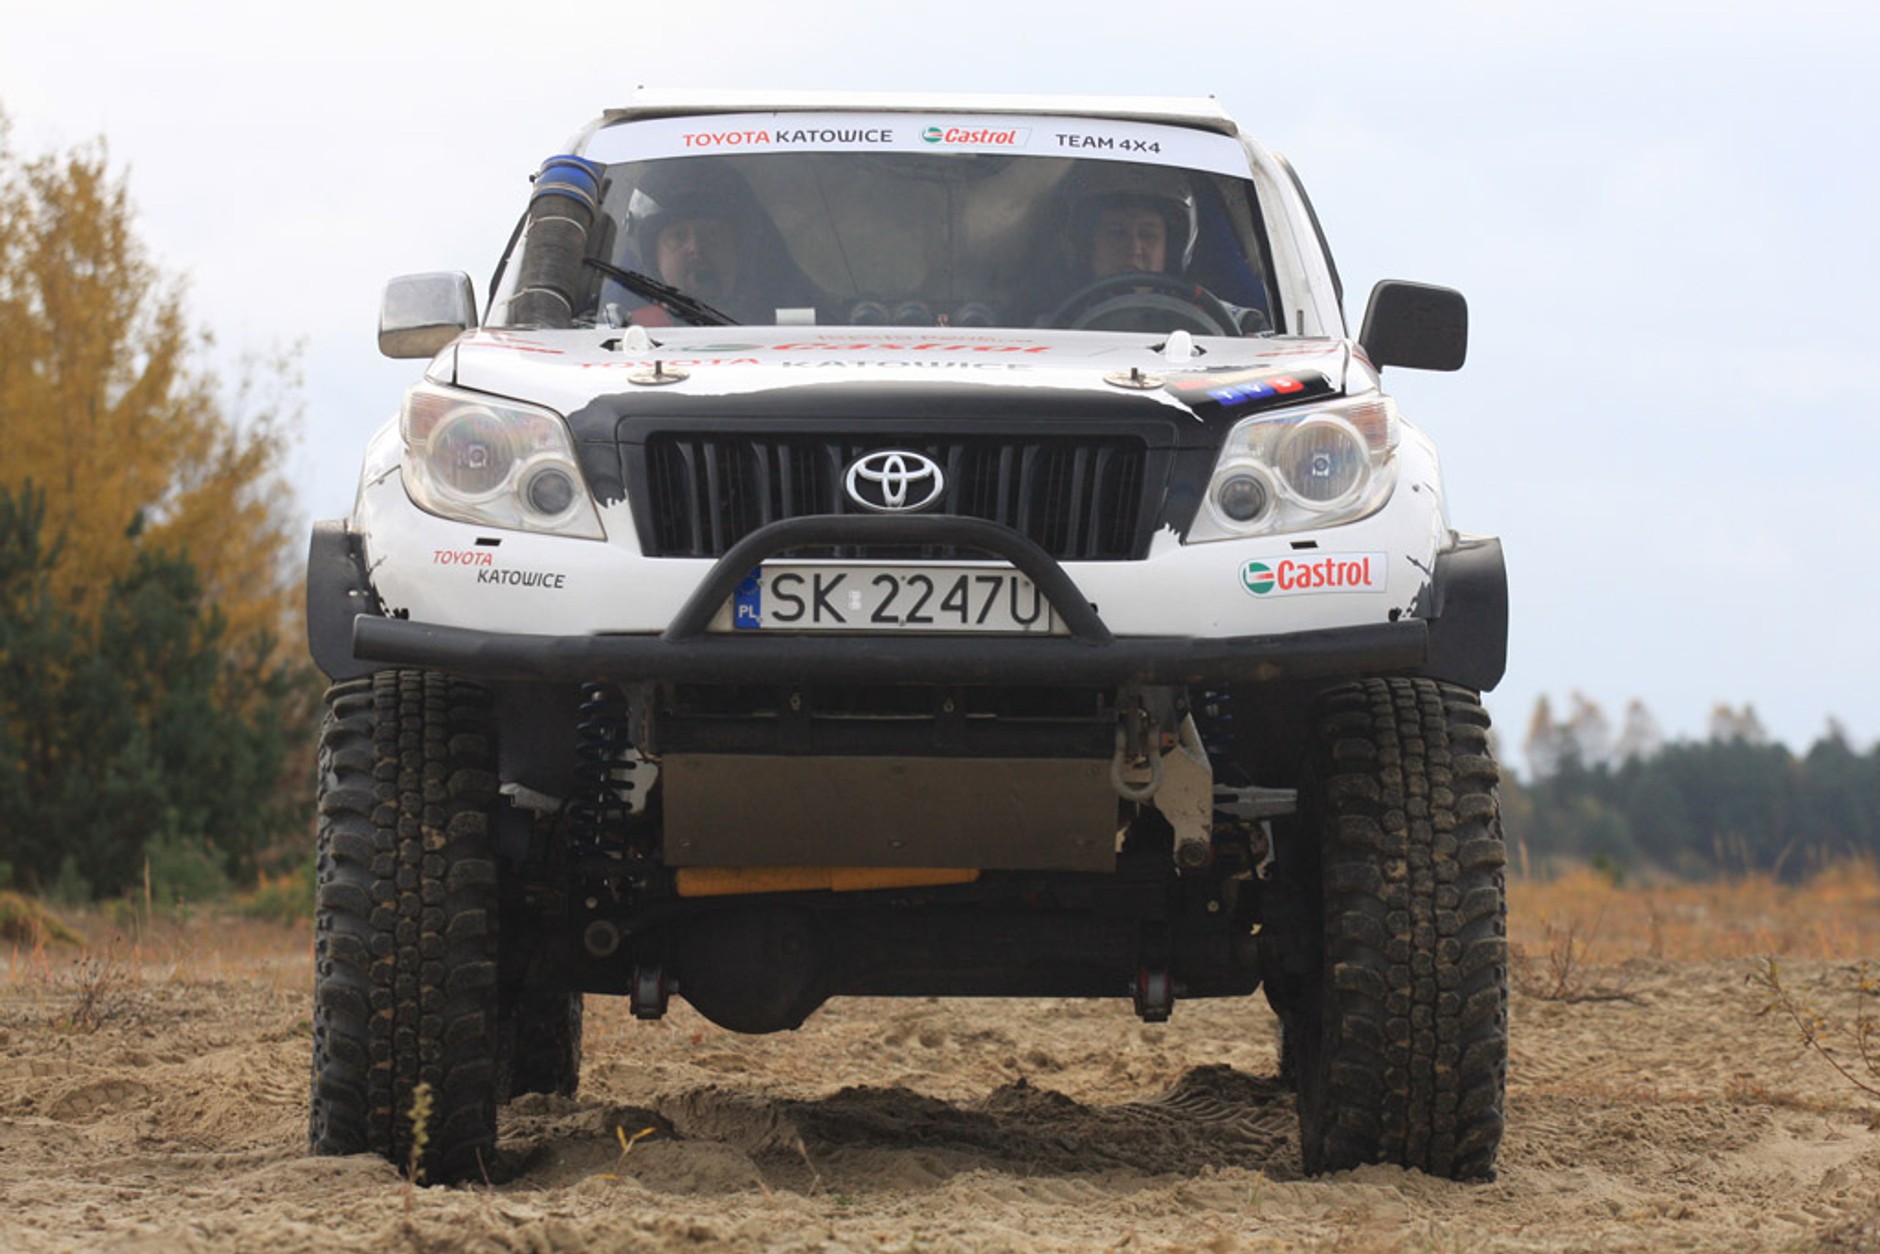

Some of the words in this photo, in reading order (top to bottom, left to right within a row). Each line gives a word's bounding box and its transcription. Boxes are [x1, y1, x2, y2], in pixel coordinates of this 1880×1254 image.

[682, 129, 770, 147] TOYOTA
[775, 129, 893, 144] KATOWICE
[944, 127, 1016, 145] Castrol
[1055, 133, 1115, 149] TEAM
[1119, 138, 1161, 153] 4X4
[432, 550, 494, 566] TOYOTA
[476, 568, 567, 589] KATOWICE
[1277, 556, 1373, 591] Castrol
[770, 572, 848, 624] SK
[869, 574, 1041, 625] 2247U
[737, 604, 757, 619] PL
